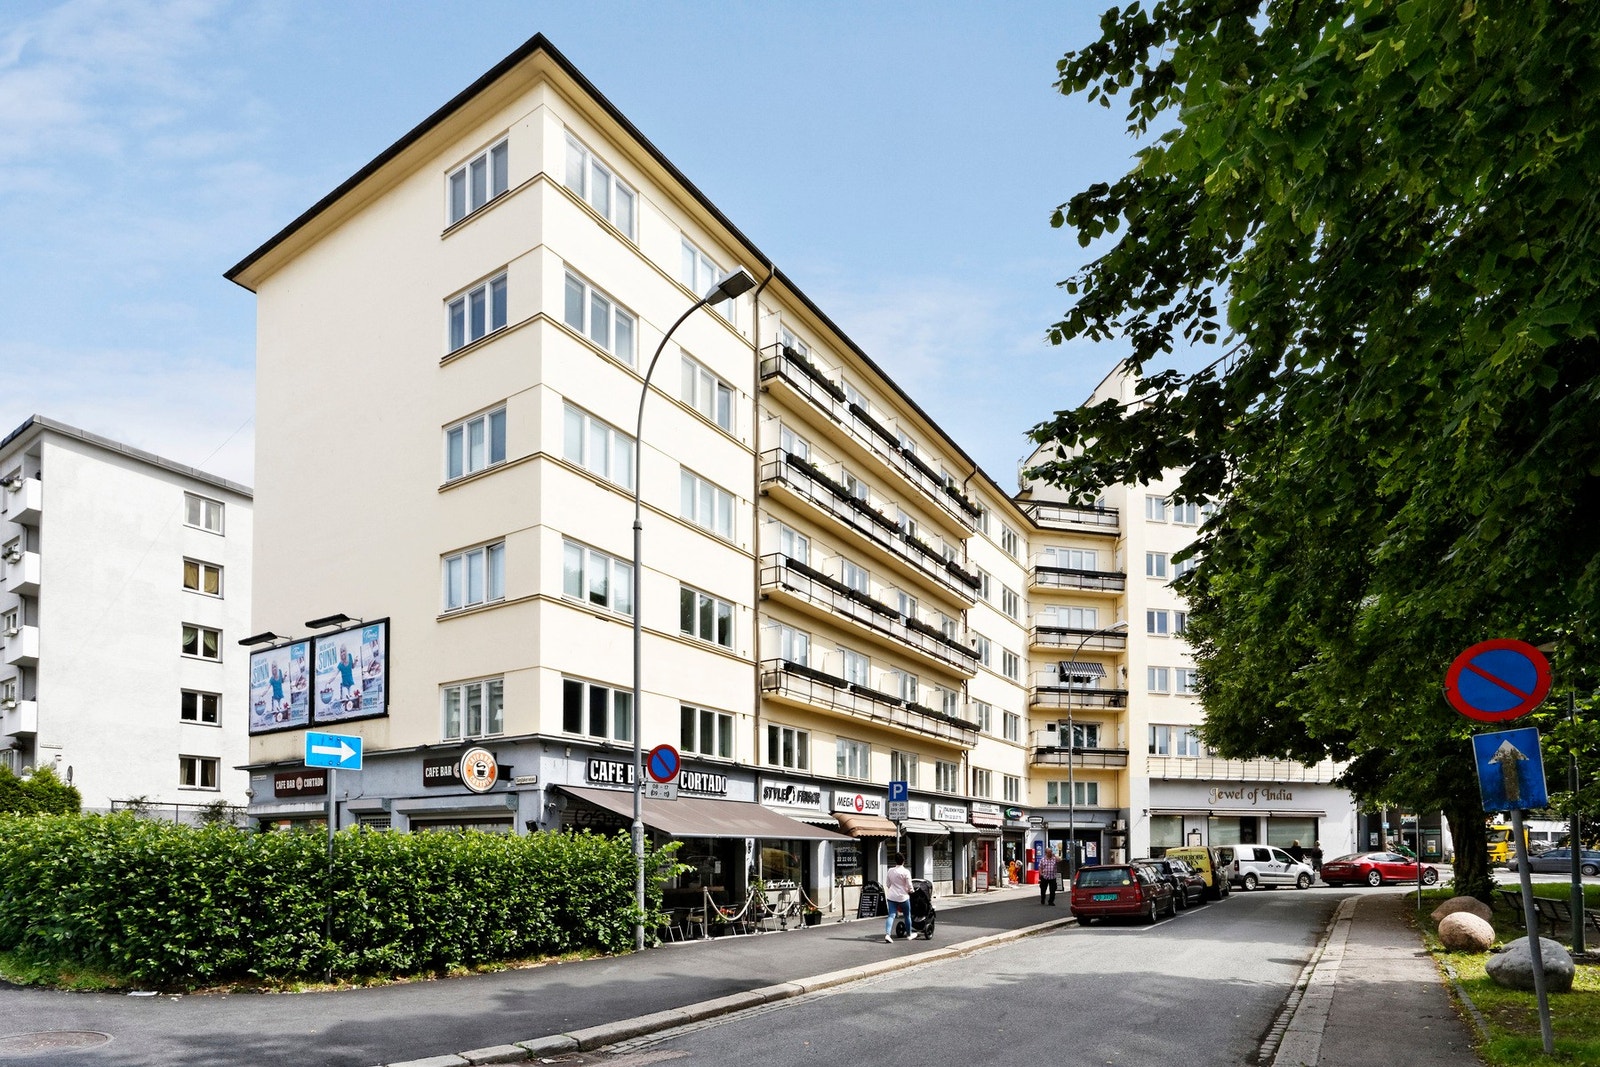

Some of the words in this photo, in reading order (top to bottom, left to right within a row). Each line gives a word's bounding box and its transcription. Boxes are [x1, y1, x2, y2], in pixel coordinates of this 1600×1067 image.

[319, 646, 338, 670] SUNN
[426, 766, 439, 778] CAFE
[440, 766, 452, 776] BAR
[590, 760, 624, 783] CAFE
[680, 771, 728, 792] CORTADO
[276, 780, 286, 789] CAFE
[287, 780, 295, 789] BAR
[304, 778, 323, 787] CORTADO
[763, 786, 786, 801] STYLE
[894, 784, 903, 799] P
[1208, 788, 1244, 804] Jewel
[1248, 788, 1259, 805] of
[1262, 788, 1292, 801] India
[837, 796, 853, 807] MEGA
[865, 800, 880, 809] SUSHI
